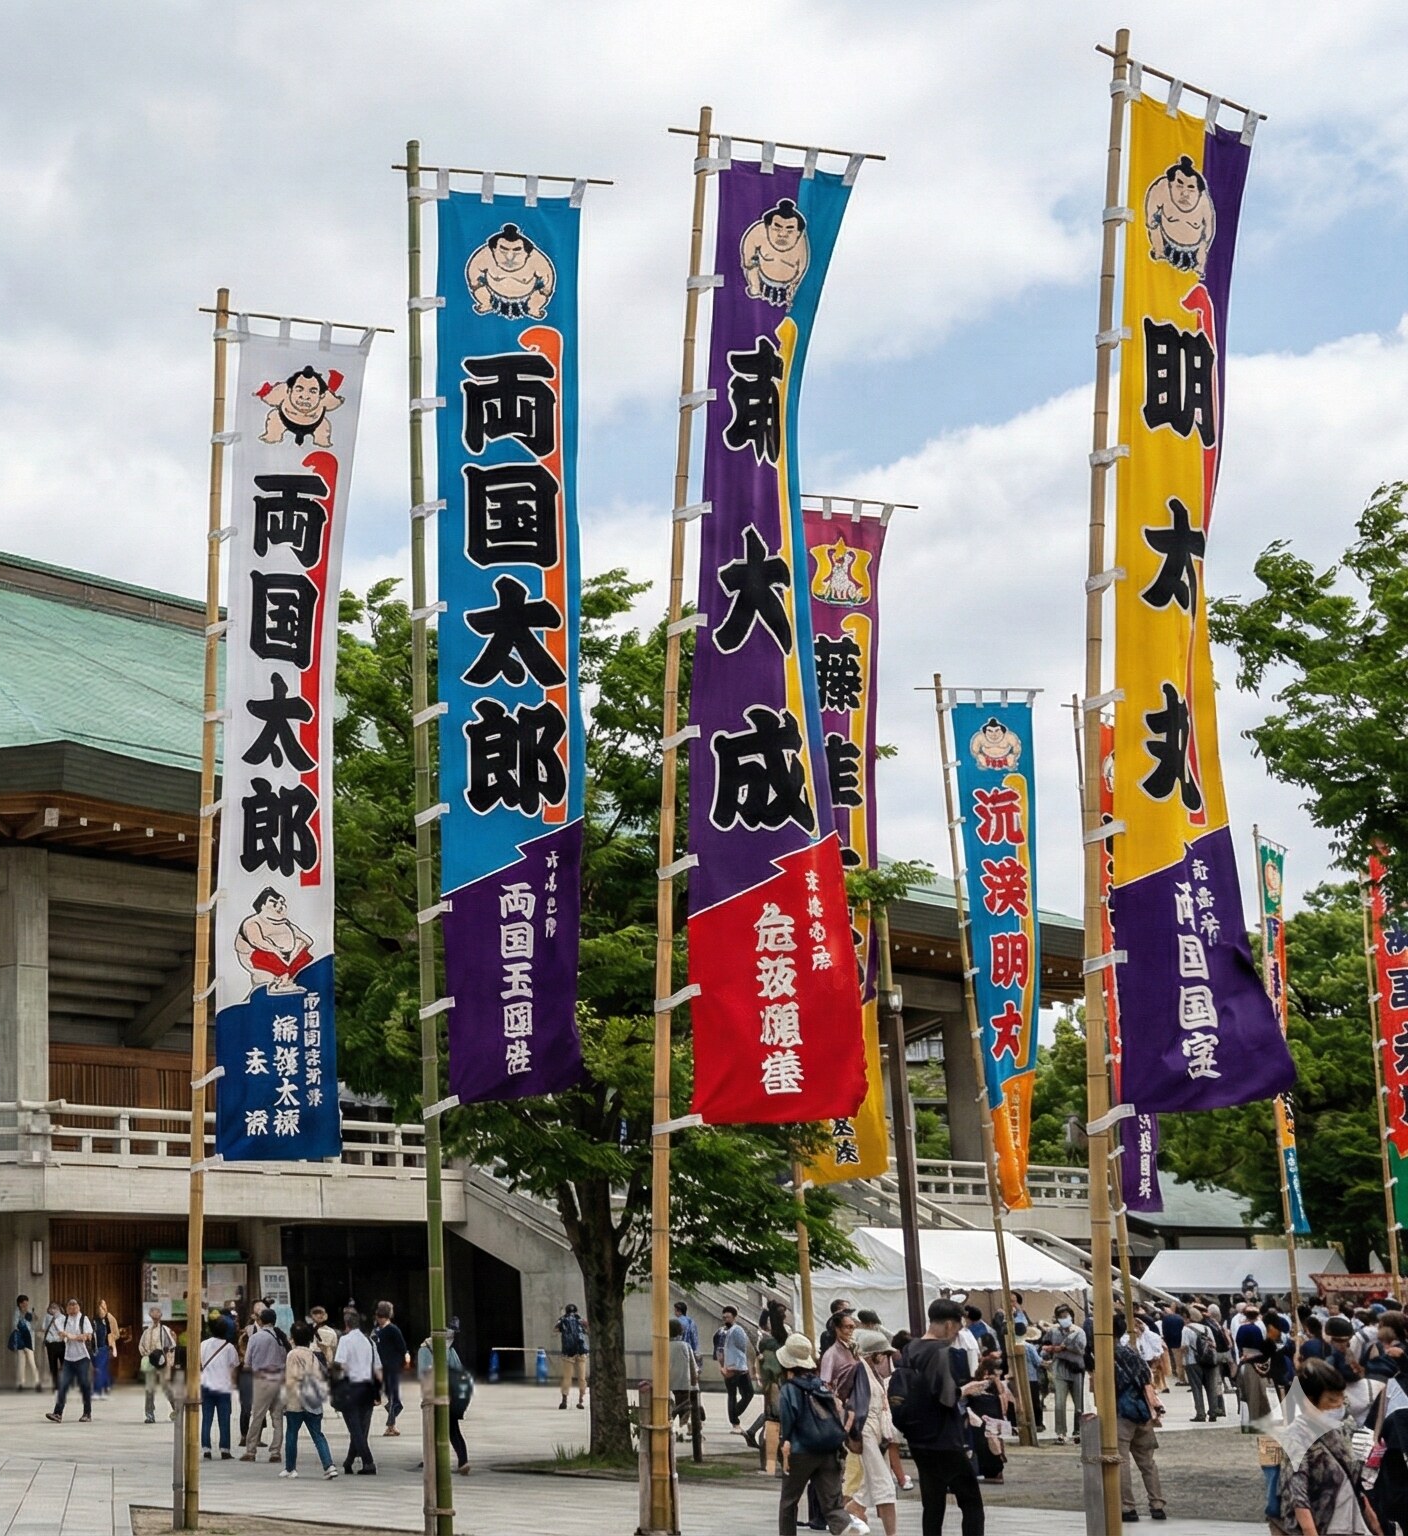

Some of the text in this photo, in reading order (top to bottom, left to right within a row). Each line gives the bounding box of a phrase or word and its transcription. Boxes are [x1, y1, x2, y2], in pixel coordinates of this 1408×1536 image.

[241, 473, 331, 877] 両国太郎
[461, 352, 569, 816] 両国太郎
